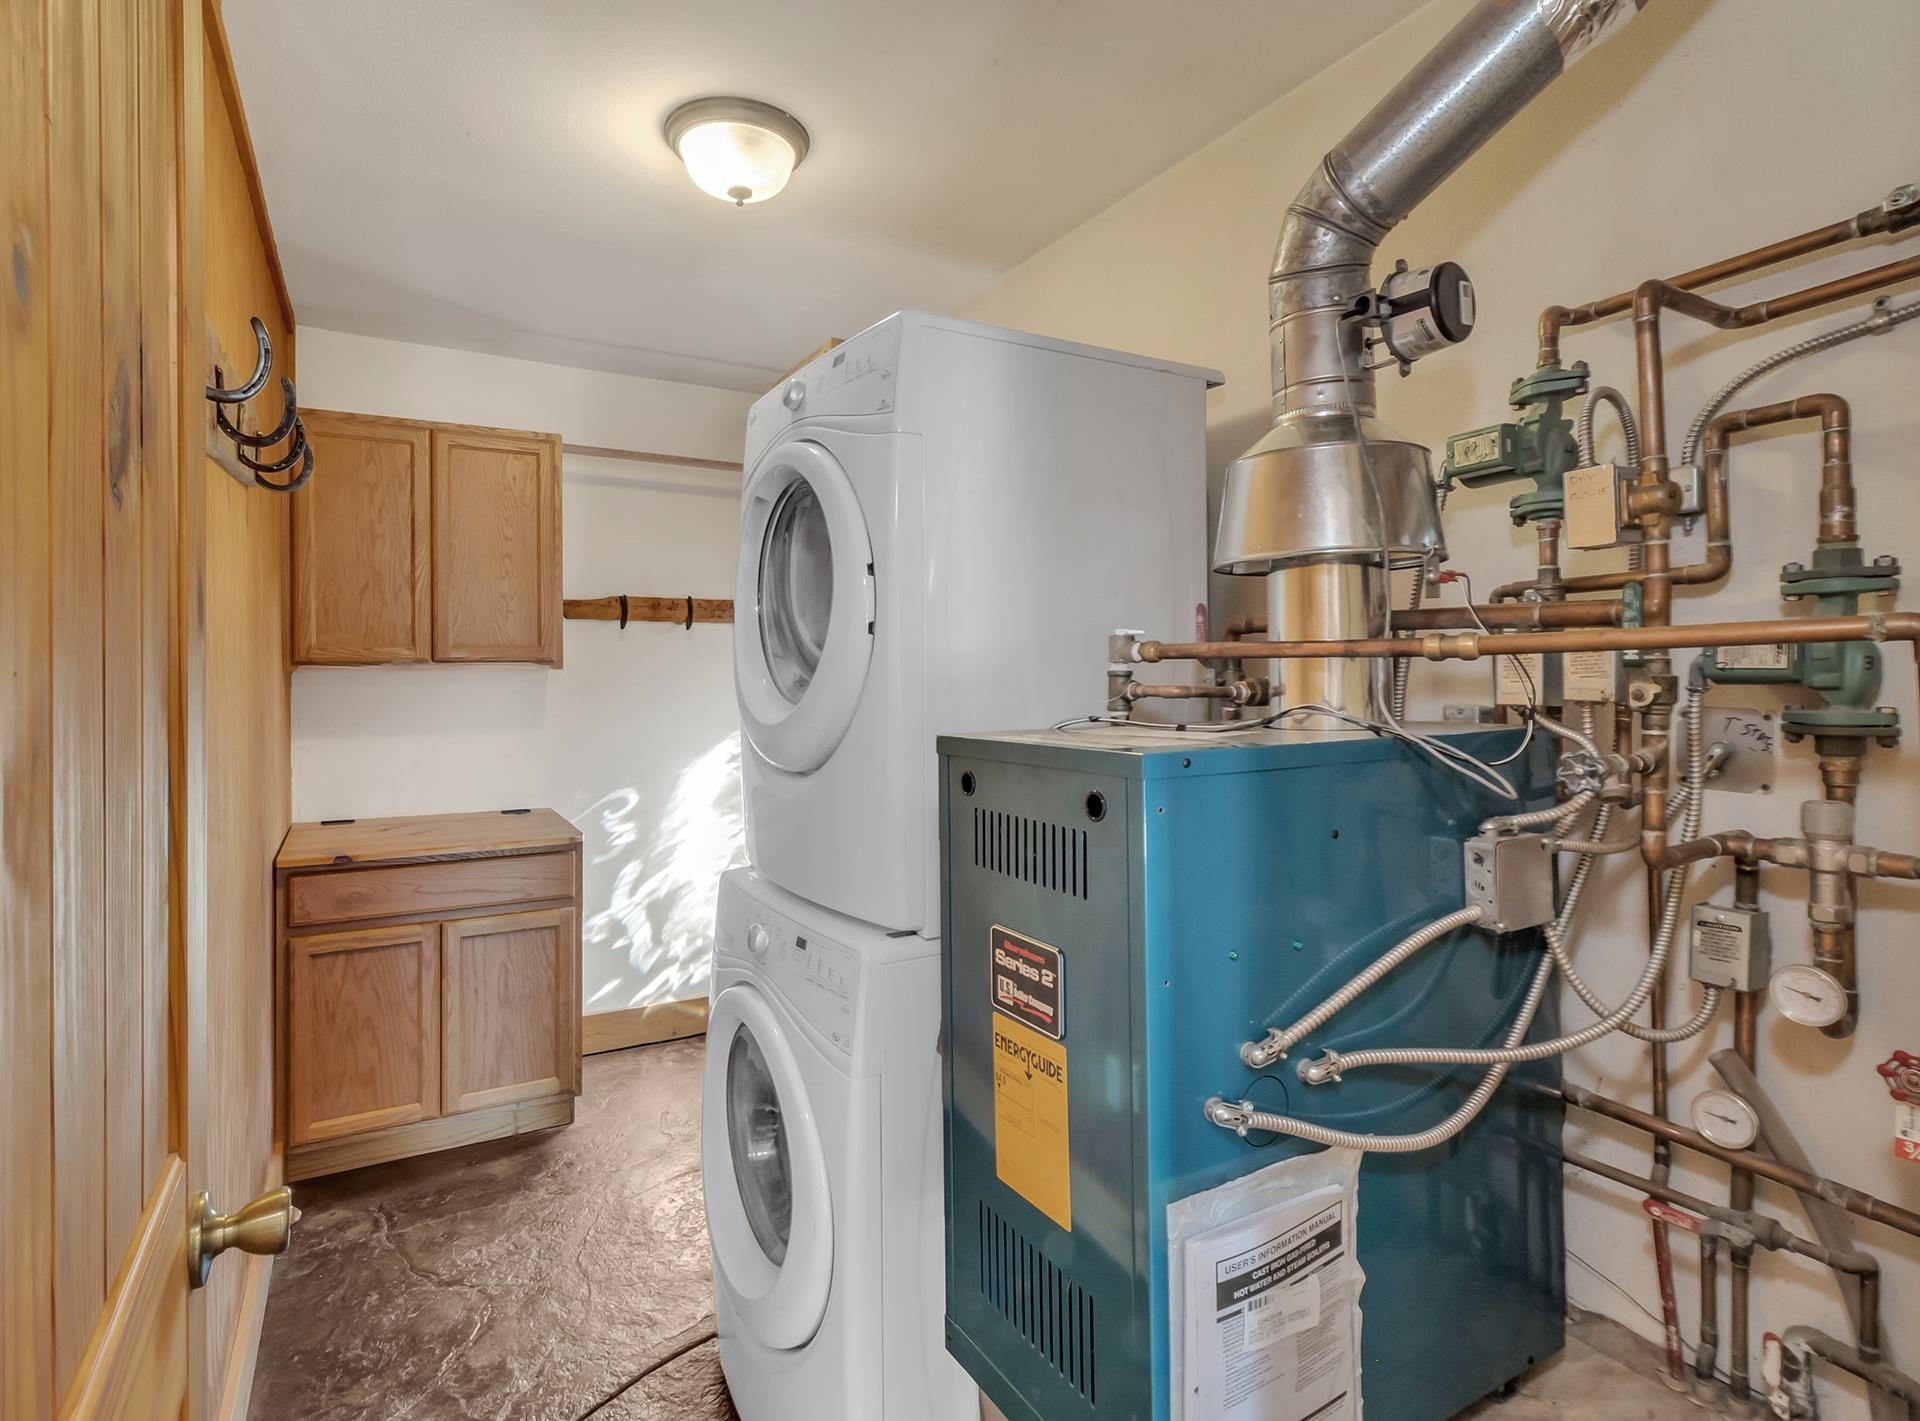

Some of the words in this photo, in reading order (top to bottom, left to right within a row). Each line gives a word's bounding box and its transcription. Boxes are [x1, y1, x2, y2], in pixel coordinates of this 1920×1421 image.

[995, 948, 1040, 982] Series
[1041, 968, 1055, 988] 2
[994, 1032, 1063, 1084] ENERGYGUIDE
[1224, 1255, 1257, 1275] USER'S
[1257, 1228, 1308, 1262] INFORMATION
[1308, 1211, 1336, 1232] MANUAL
[1252, 1263, 1270, 1280] CAST
[1270, 1257, 1286, 1271] IRON
[1232, 1286, 1250, 1300] HOT
[1249, 1276, 1273, 1292] WATER
[1273, 1269, 1287, 1281] AND
[1286, 1257, 1307, 1274] STEAM
[1306, 1241, 1331, 1262] BOILERS
